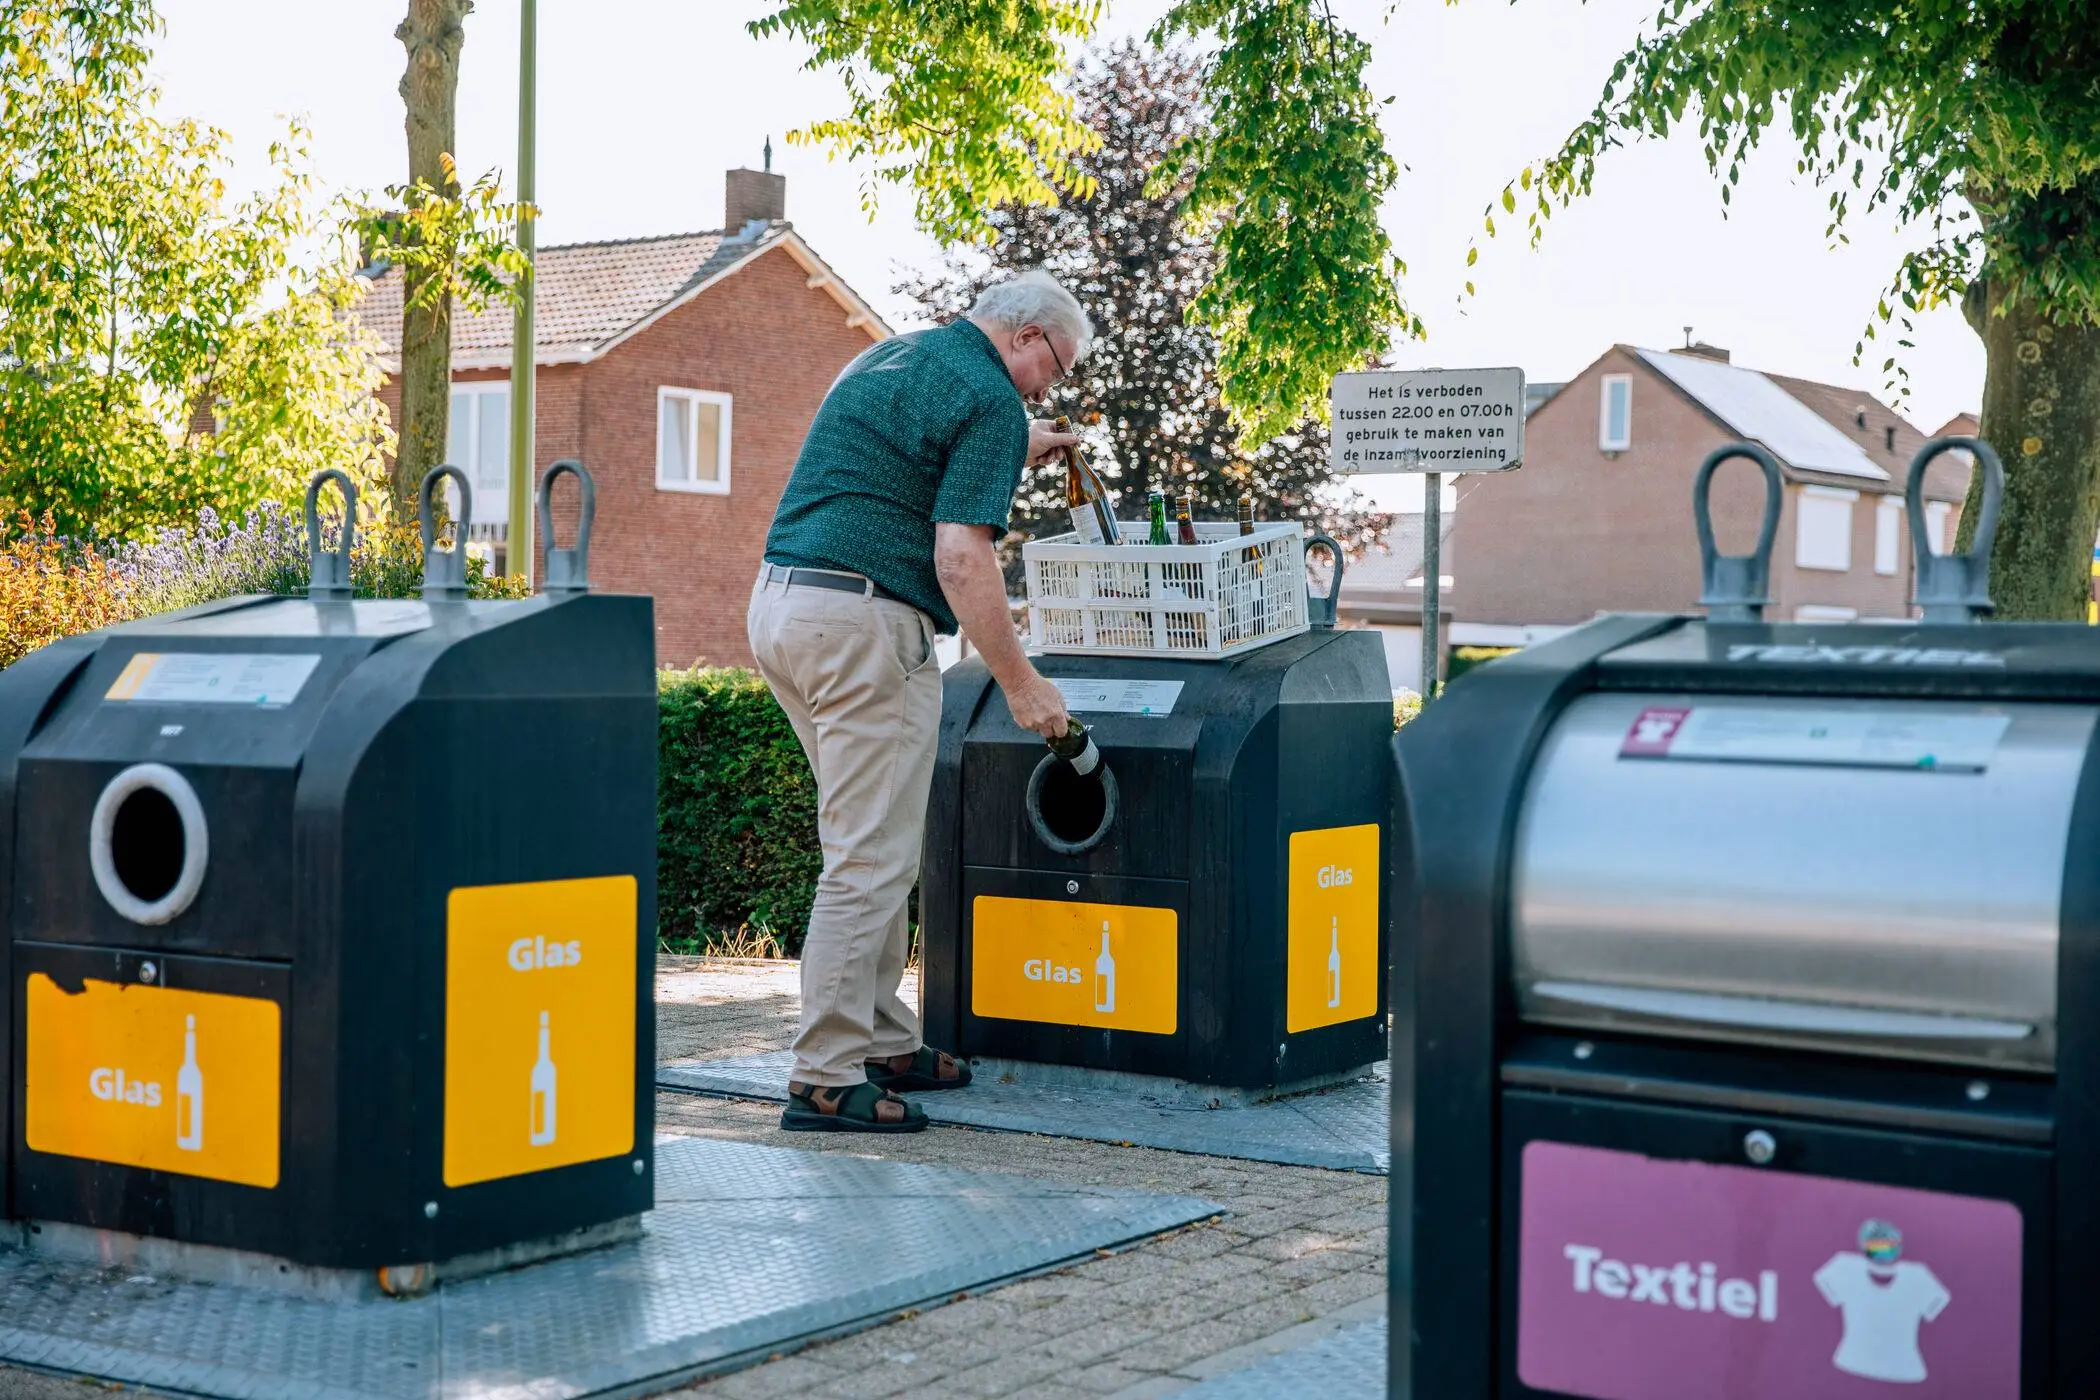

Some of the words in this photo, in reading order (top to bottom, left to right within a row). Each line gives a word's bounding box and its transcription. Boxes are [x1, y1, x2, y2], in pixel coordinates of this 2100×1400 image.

[1368, 386, 1394, 399] Het
[1399, 385, 1411, 398] is
[1416, 384, 1483, 398] verboden
[1339, 408, 1387, 420] tussen
[1392, 405, 1434, 419] 22.00
[1438, 408, 1455, 418] en
[1346, 427, 1399, 444] gebruik
[1404, 427, 1419, 439] te
[1424, 426, 1472, 439] maken
[1478, 427, 1504, 438] van
[1343, 448, 1359, 461] de
[1318, 864, 1353, 889] Glas
[508, 936, 582, 972] Glas
[1023, 959, 1083, 984] Glas
[89, 1067, 162, 1107] Glas
[1565, 1244, 1778, 1322] Textiel
